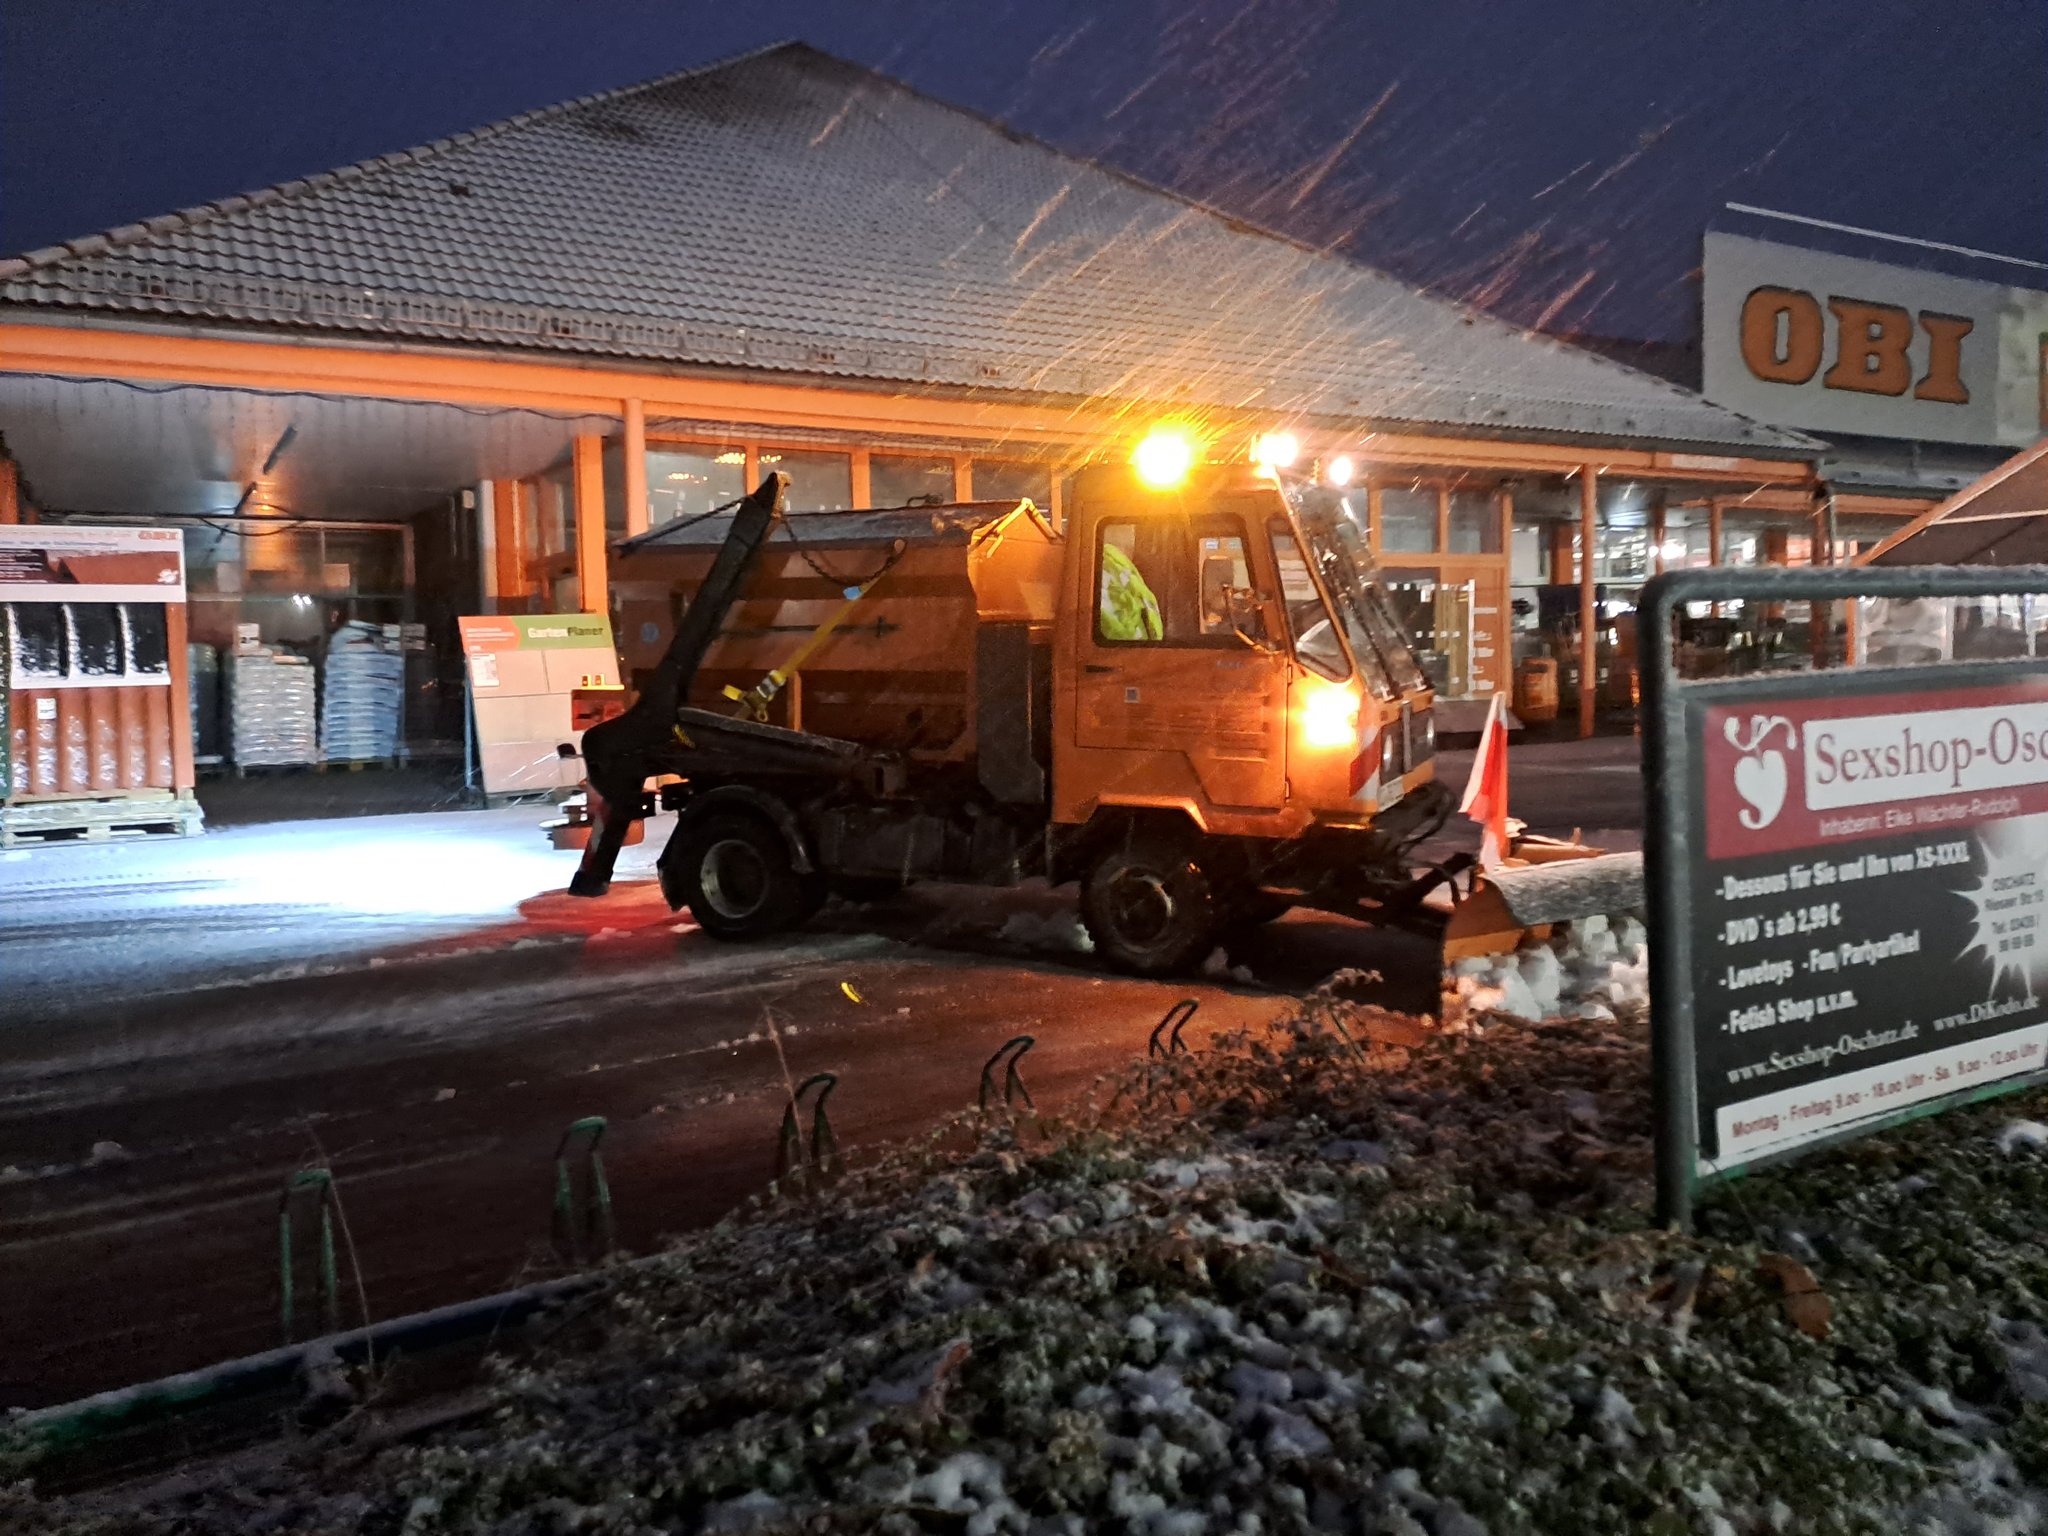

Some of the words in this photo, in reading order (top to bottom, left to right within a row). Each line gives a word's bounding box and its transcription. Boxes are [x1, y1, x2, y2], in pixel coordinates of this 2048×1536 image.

[1740, 284, 1975, 405] OBI
[1723, 875, 1788, 900] Dessous
[1813, 861, 1837, 886] Sie
[1838, 856, 1865, 882] und
[1776, 911, 1796, 936] ab
[1797, 905, 1829, 935] 2,99
[1729, 1003, 1776, 1034] Fetish
[1777, 997, 1815, 1022] Shop
